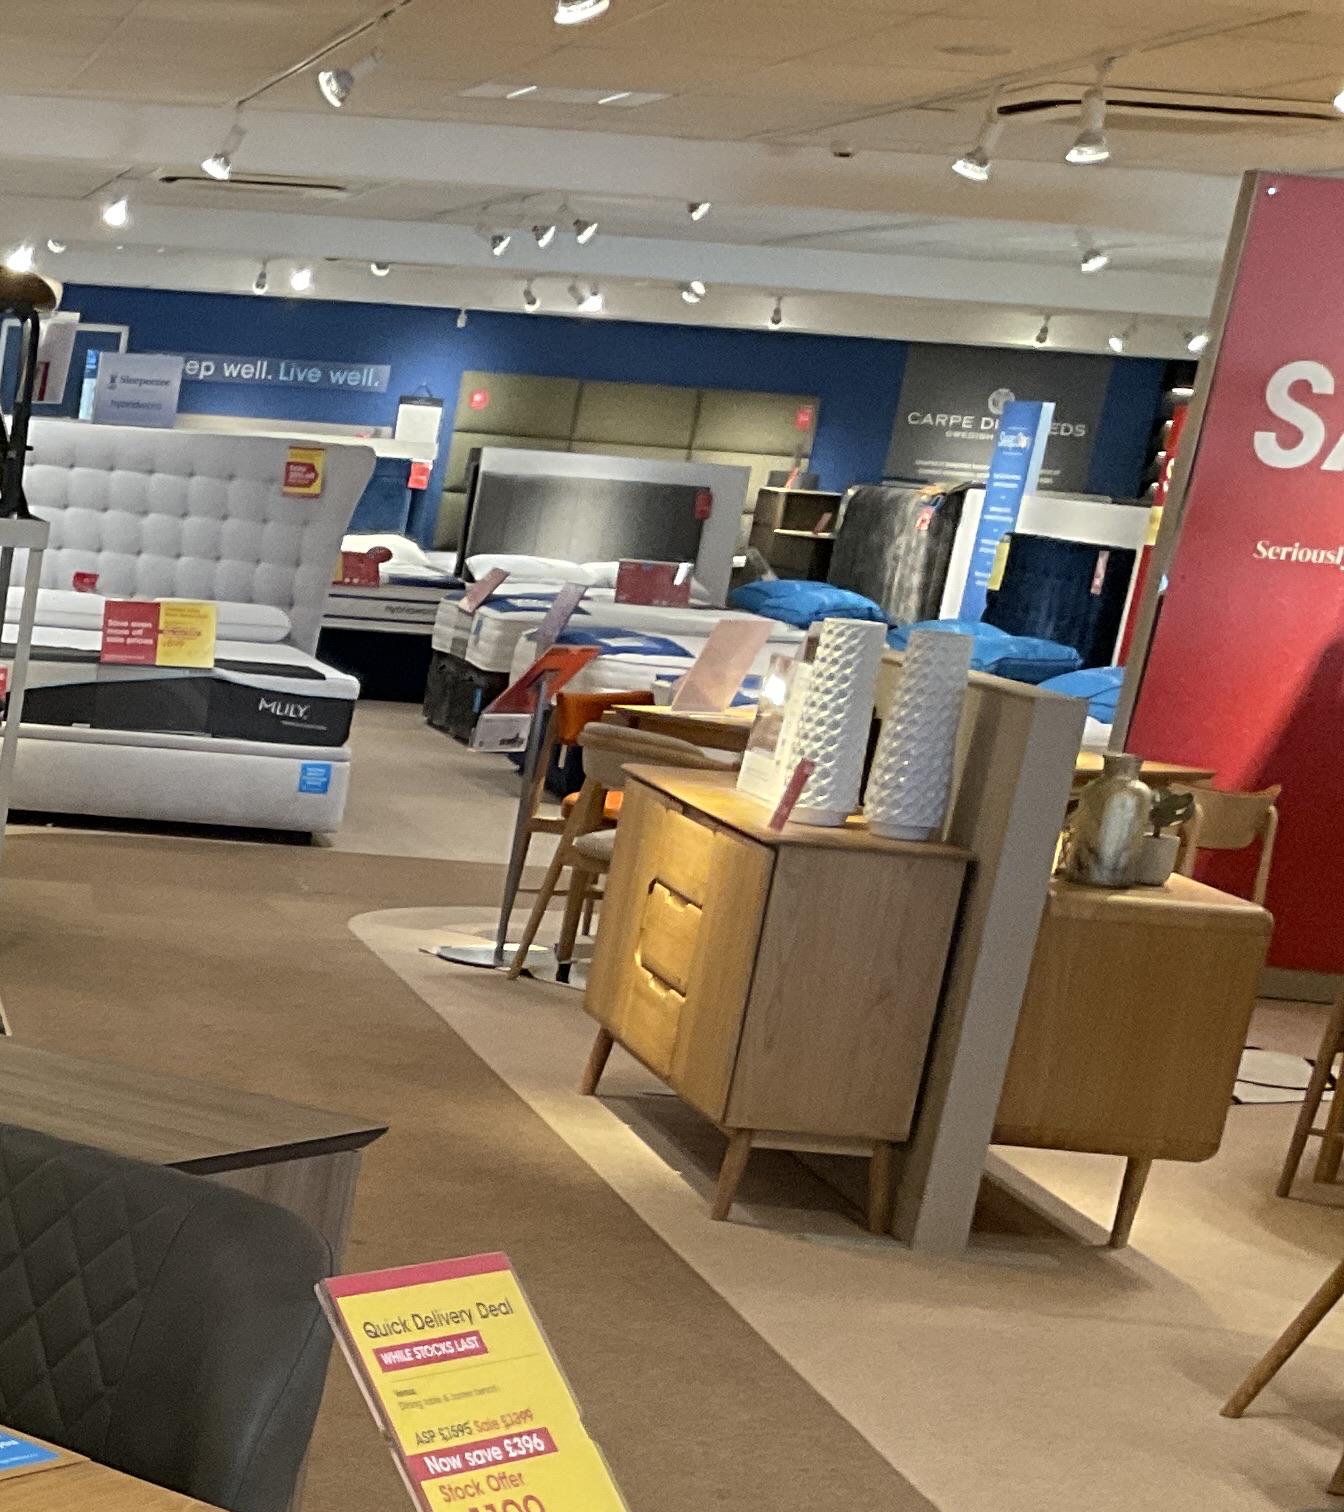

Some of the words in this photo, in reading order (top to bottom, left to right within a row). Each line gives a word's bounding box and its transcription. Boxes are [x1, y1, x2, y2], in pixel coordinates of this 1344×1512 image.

[223, 360, 272, 380] well.
[279, 361, 322, 383] Live
[330, 367, 380, 387] well.
[908, 412, 974, 429] CARPE
[980, 417, 998, 430] DI
[1047, 422, 1087, 437] EDS
[1254, 361, 1344, 471] S
[1253, 540, 1344, 571] Seriousl
[363, 1316, 412, 1338] Quick
[411, 1309, 473, 1330] Delivery
[476, 1298, 514, 1319] Deal
[380, 1349, 414, 1365] WHILE
[413, 1342, 454, 1360] STOCKS
[454, 1336, 480, 1353] LAST
[416, 1429, 435, 1446] ASP
[424, 1454, 462, 1474] Now
[465, 1446, 503, 1467] save
[504, 1433, 545, 1457] £396
[439, 1480, 485, 1503] Stock
[486, 1472, 525, 1492] Offer
